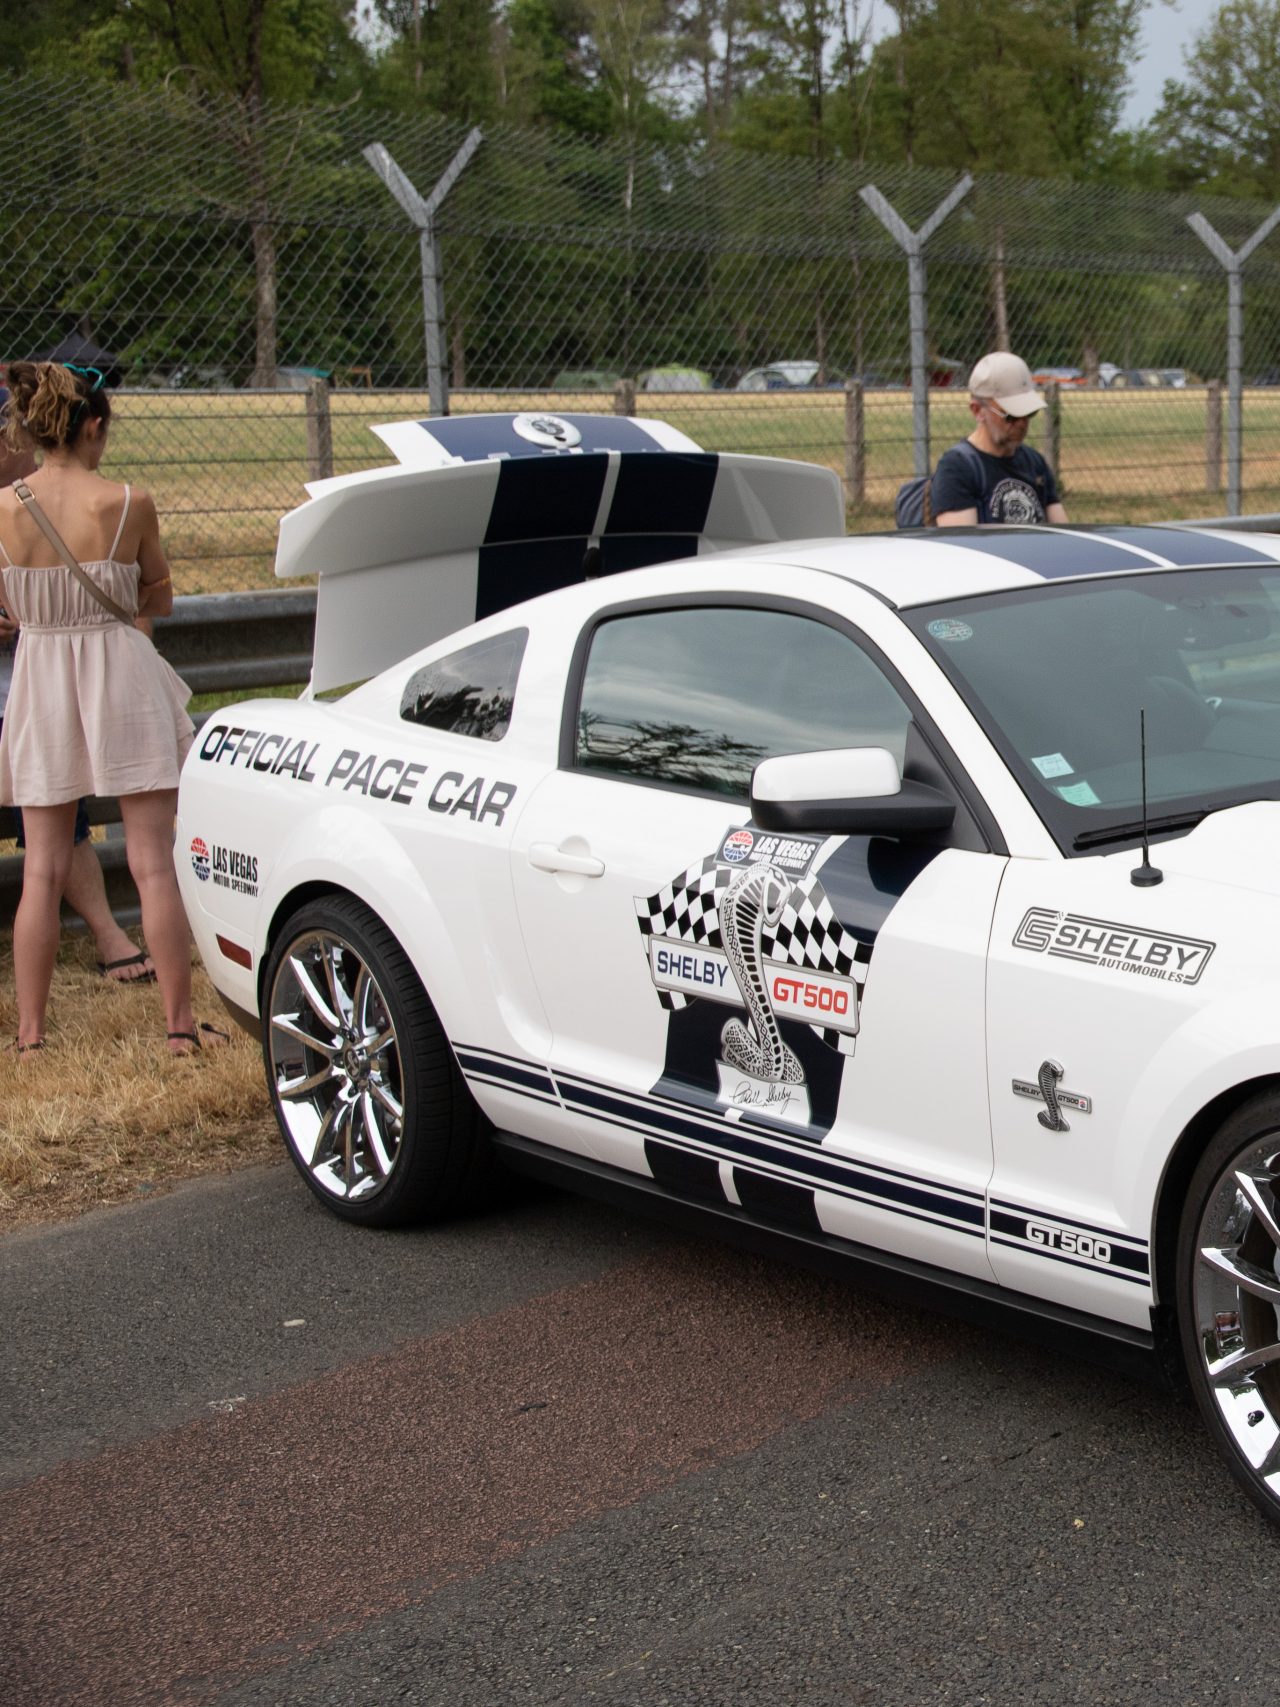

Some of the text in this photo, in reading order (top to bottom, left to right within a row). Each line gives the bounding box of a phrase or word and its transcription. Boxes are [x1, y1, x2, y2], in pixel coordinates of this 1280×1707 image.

[200, 725, 518, 827] OFFICIAL PACE CAR
[213, 845, 258, 883] LAS VEGAS
[754, 836, 815, 860] LAS VEGAS
[213, 873, 258, 897] MOTOR SPEEDWAY
[1055, 924, 1200, 970] SHELBY
[657, 950, 848, 1015] SHELBY GT500
[1098, 958, 1185, 983] AUTOMOBILES
[1013, 1084, 1079, 1105] SHELBY GT500
[1026, 1221, 1111, 1263] GT500
